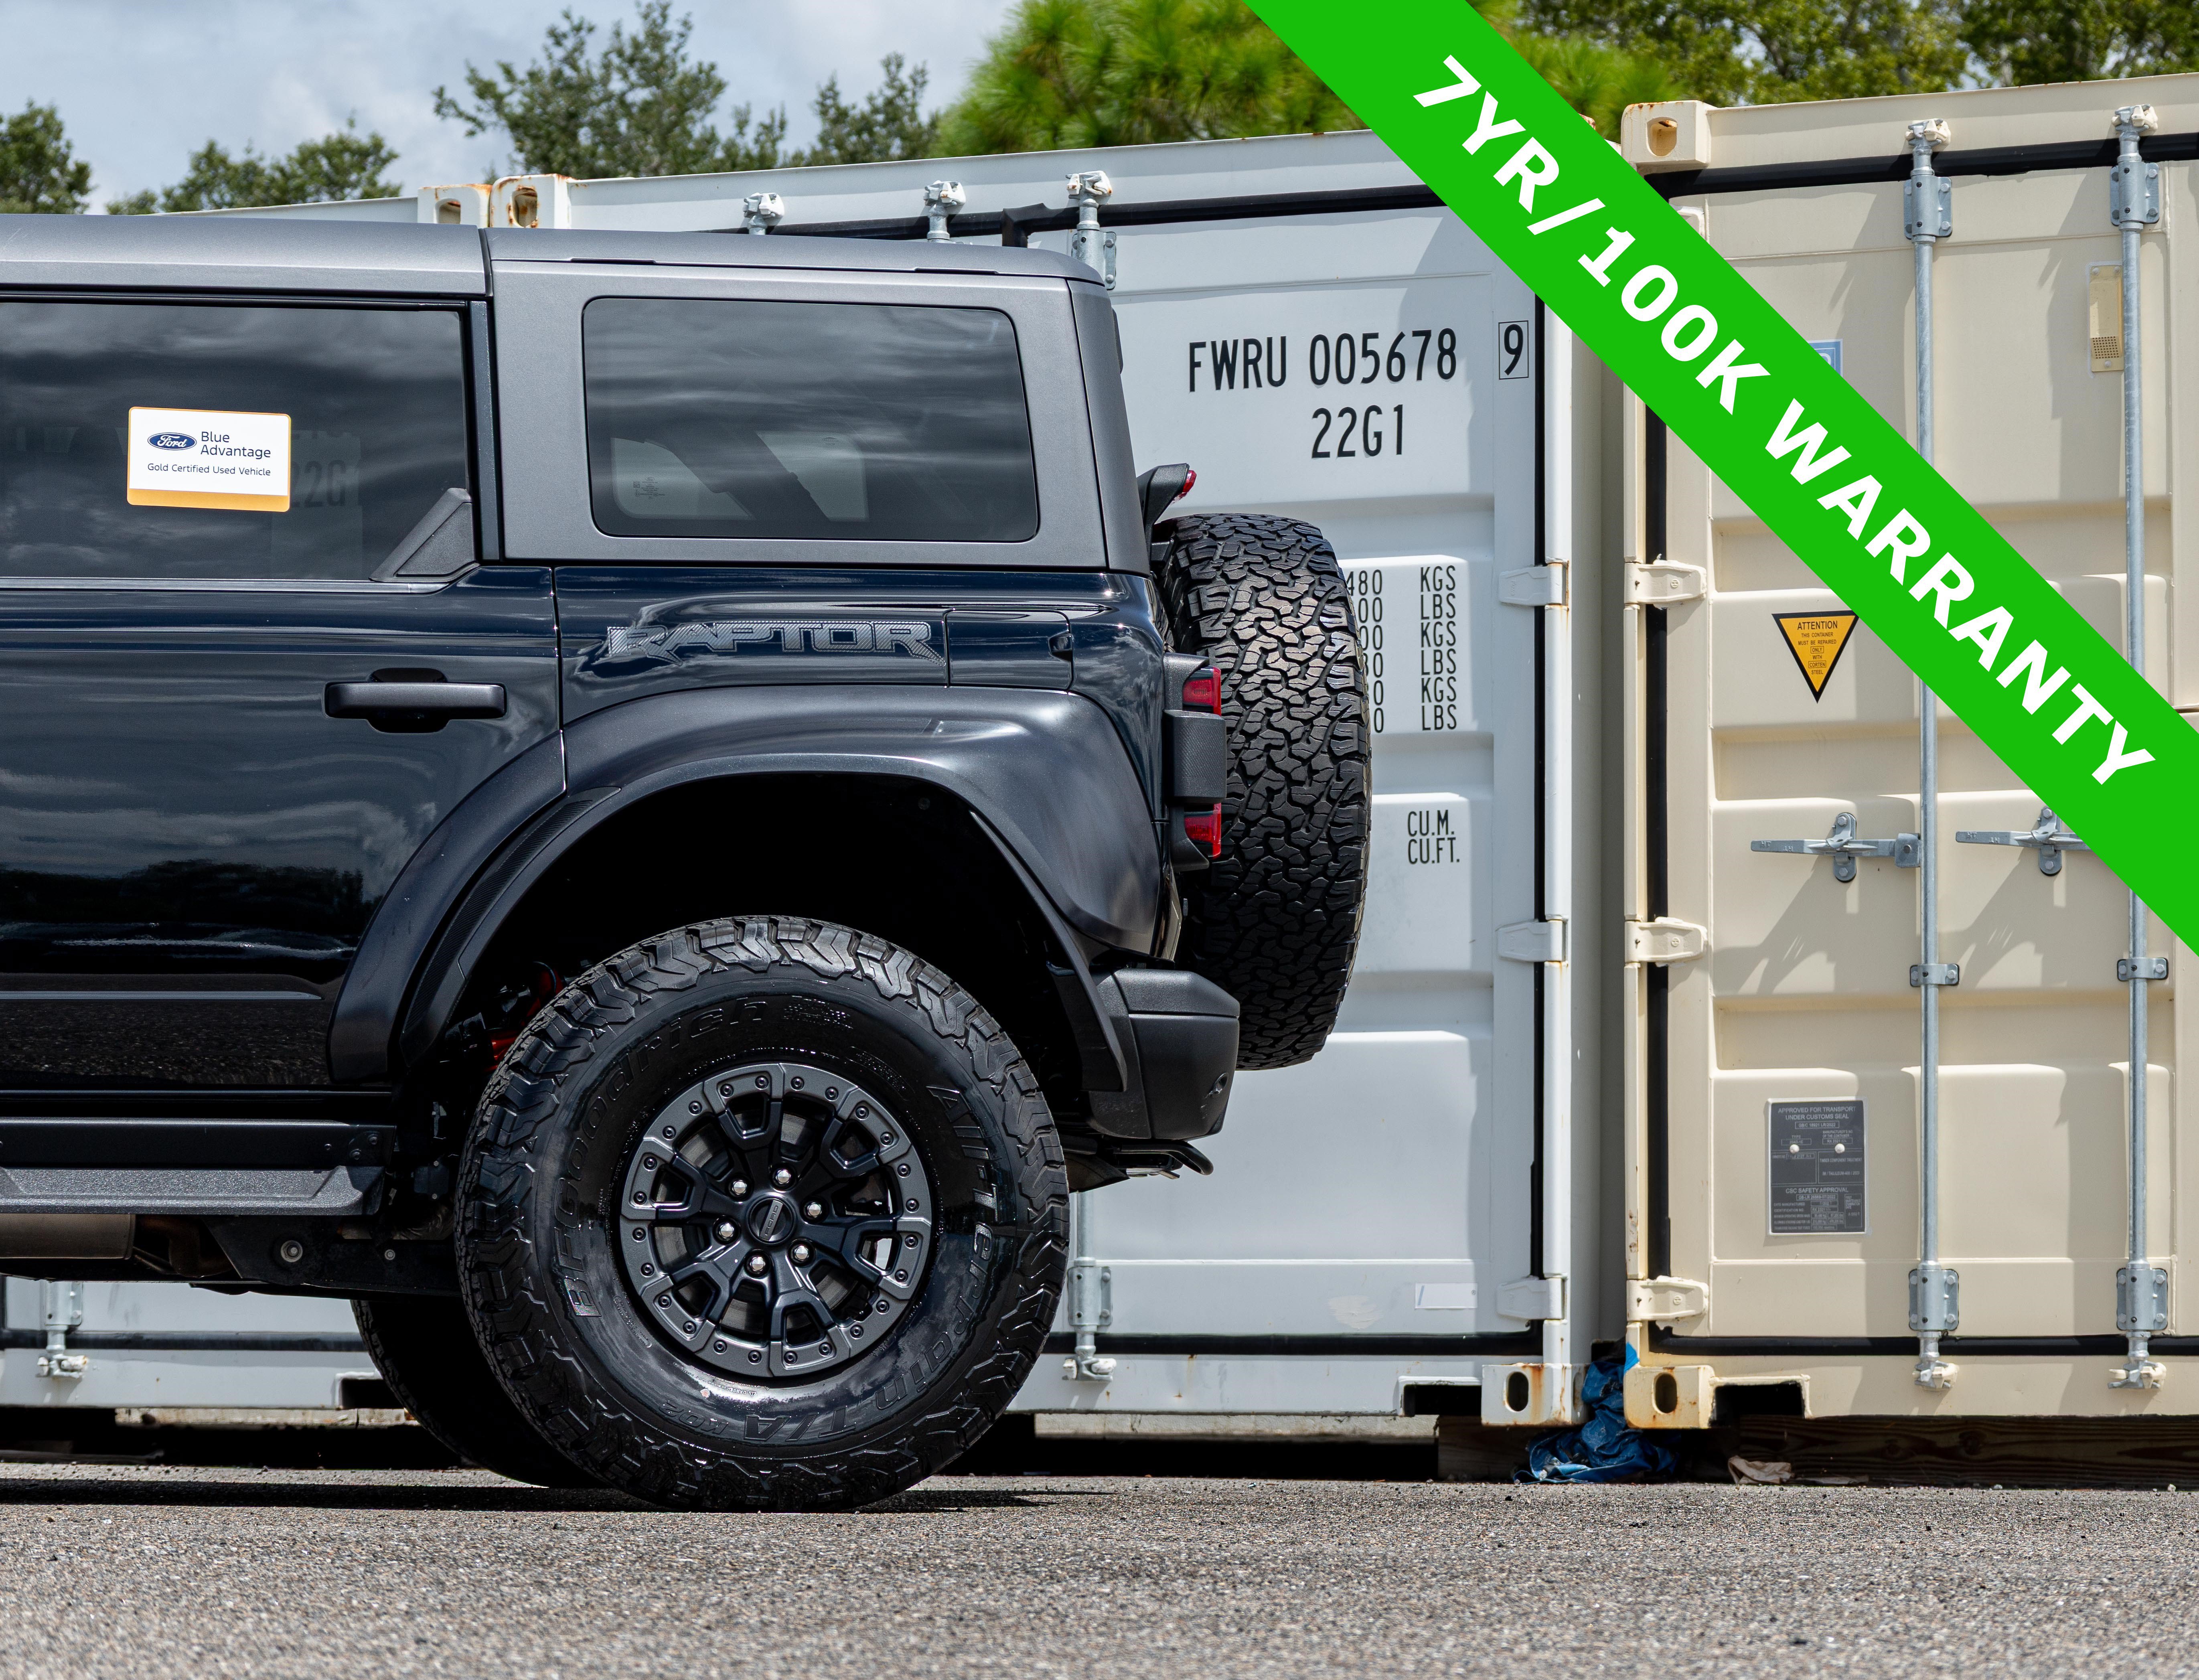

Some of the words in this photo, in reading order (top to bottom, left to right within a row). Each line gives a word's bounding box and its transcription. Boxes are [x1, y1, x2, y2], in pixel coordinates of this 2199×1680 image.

[1189, 335, 1287, 392] FWRU
[1309, 328, 1457, 386] 005678
[1504, 324, 1524, 375] 9
[201, 431, 230, 443] Blue
[1311, 404, 1404, 458] 22G1
[201, 444, 271, 459] Advantage
[148, 463, 168, 472] Gold
[172, 464, 209, 473] Certified
[213, 466, 235, 474] Used
[239, 467, 271, 476] Vehicle
[1421, 565, 1456, 592] KGS
[1421, 593, 1456, 620] LBS
[1421, 620, 1456, 648] KGS
[1798, 620, 1838, 630] ATTENTION
[607, 620, 946, 666] RAPTOR
[1421, 648, 1457, 675] LBS
[1421, 676, 1457, 703] KGS
[1422, 704, 1457, 731] LBS
[1408, 809, 1454, 837] CU.M.
[1408, 837, 1460, 865] CU.FT.
[554, 997, 767, 1317] BFGoodrich
[764, 1205, 779, 1236] FORD
[727, 1386, 747, 1395] DANGER
[744, 1405, 856, 1441] T/A
